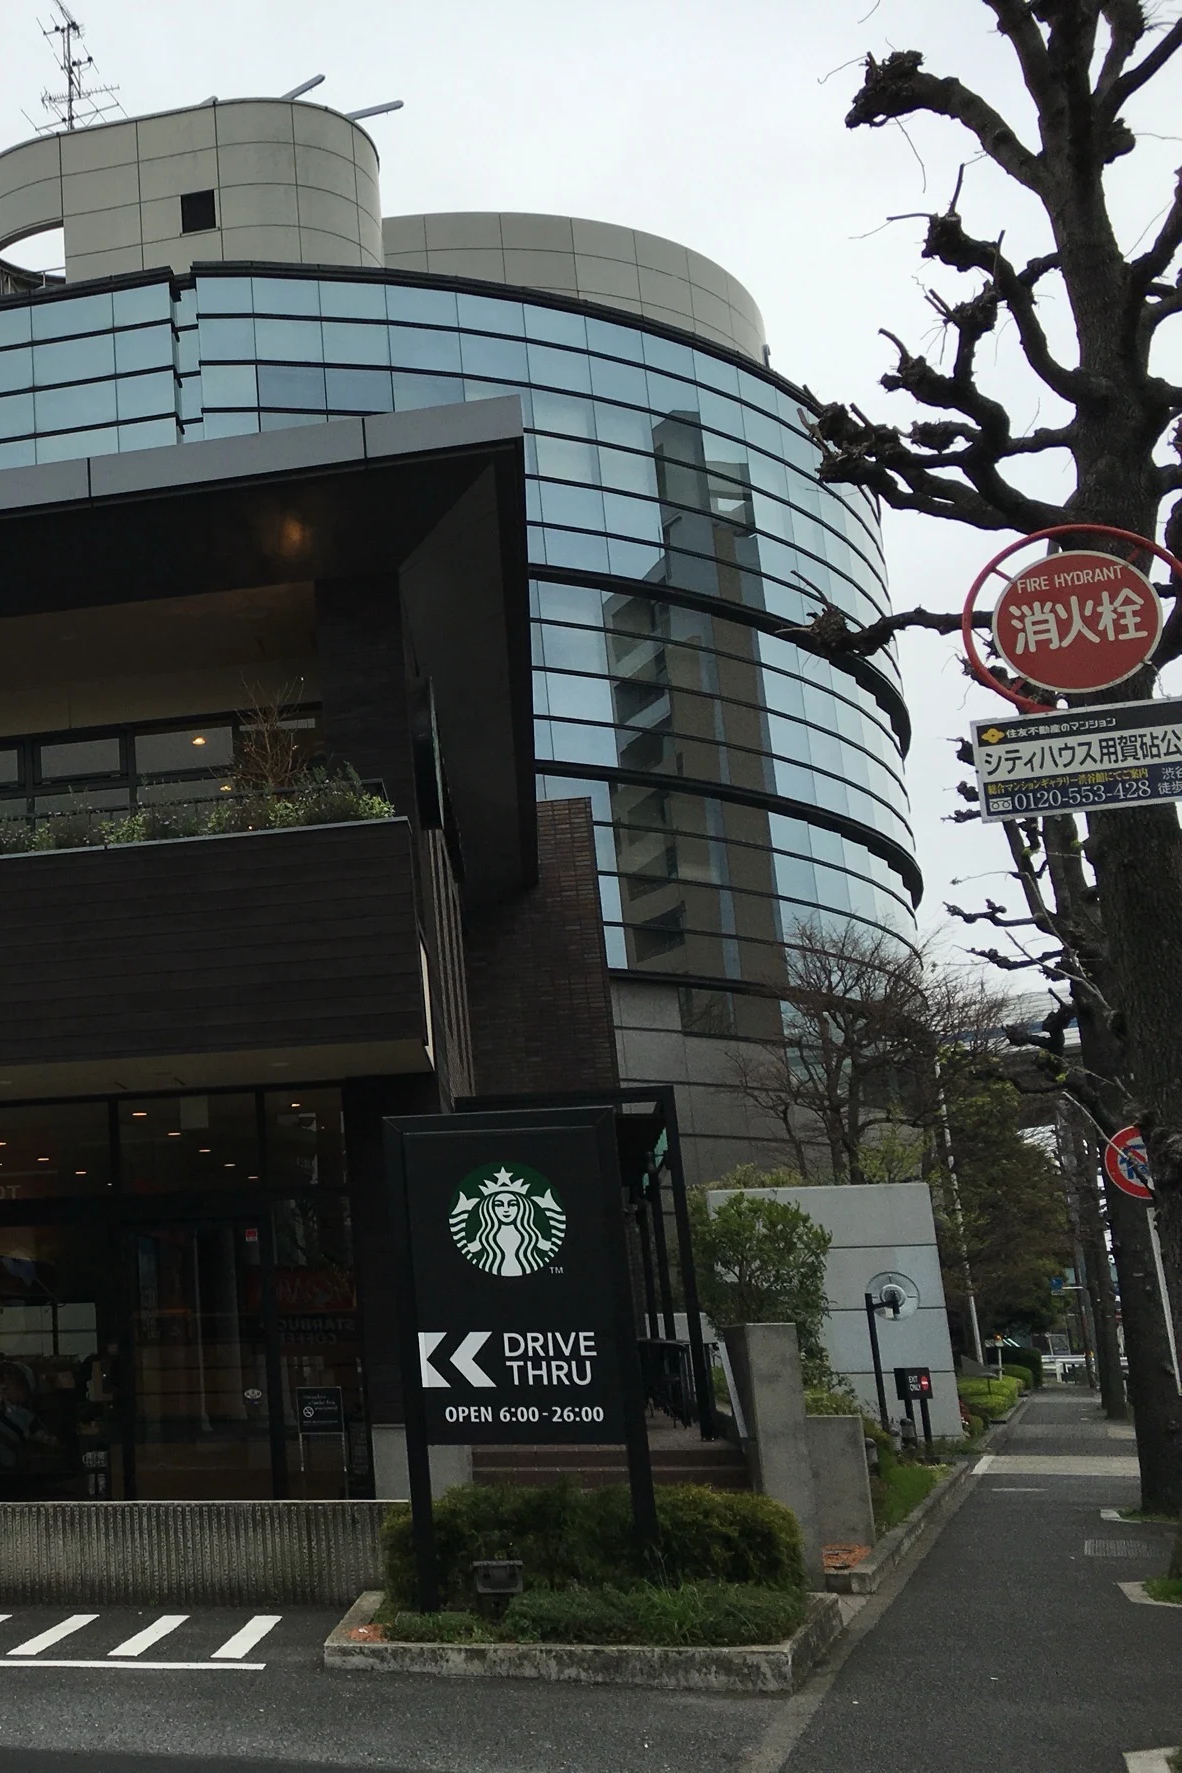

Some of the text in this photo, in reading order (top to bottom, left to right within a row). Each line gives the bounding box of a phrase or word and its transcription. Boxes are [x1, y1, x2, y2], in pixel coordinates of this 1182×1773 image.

[1017, 565, 1123, 594] FIRE HYDRANT
[1008, 587, 1149, 655] 消火栓
[1005, 717, 1117, 739] 住友不動産のマンション
[984, 729, 1182, 777] シティハウス用賀砧公
[1014, 779, 1151, 811] 0120-553-428
[549, 1266, 564, 1274] TM
[503, 1331, 598, 1357] DRIVE
[505, 1360, 593, 1386] THRU
[445, 1406, 494, 1423] OPEN
